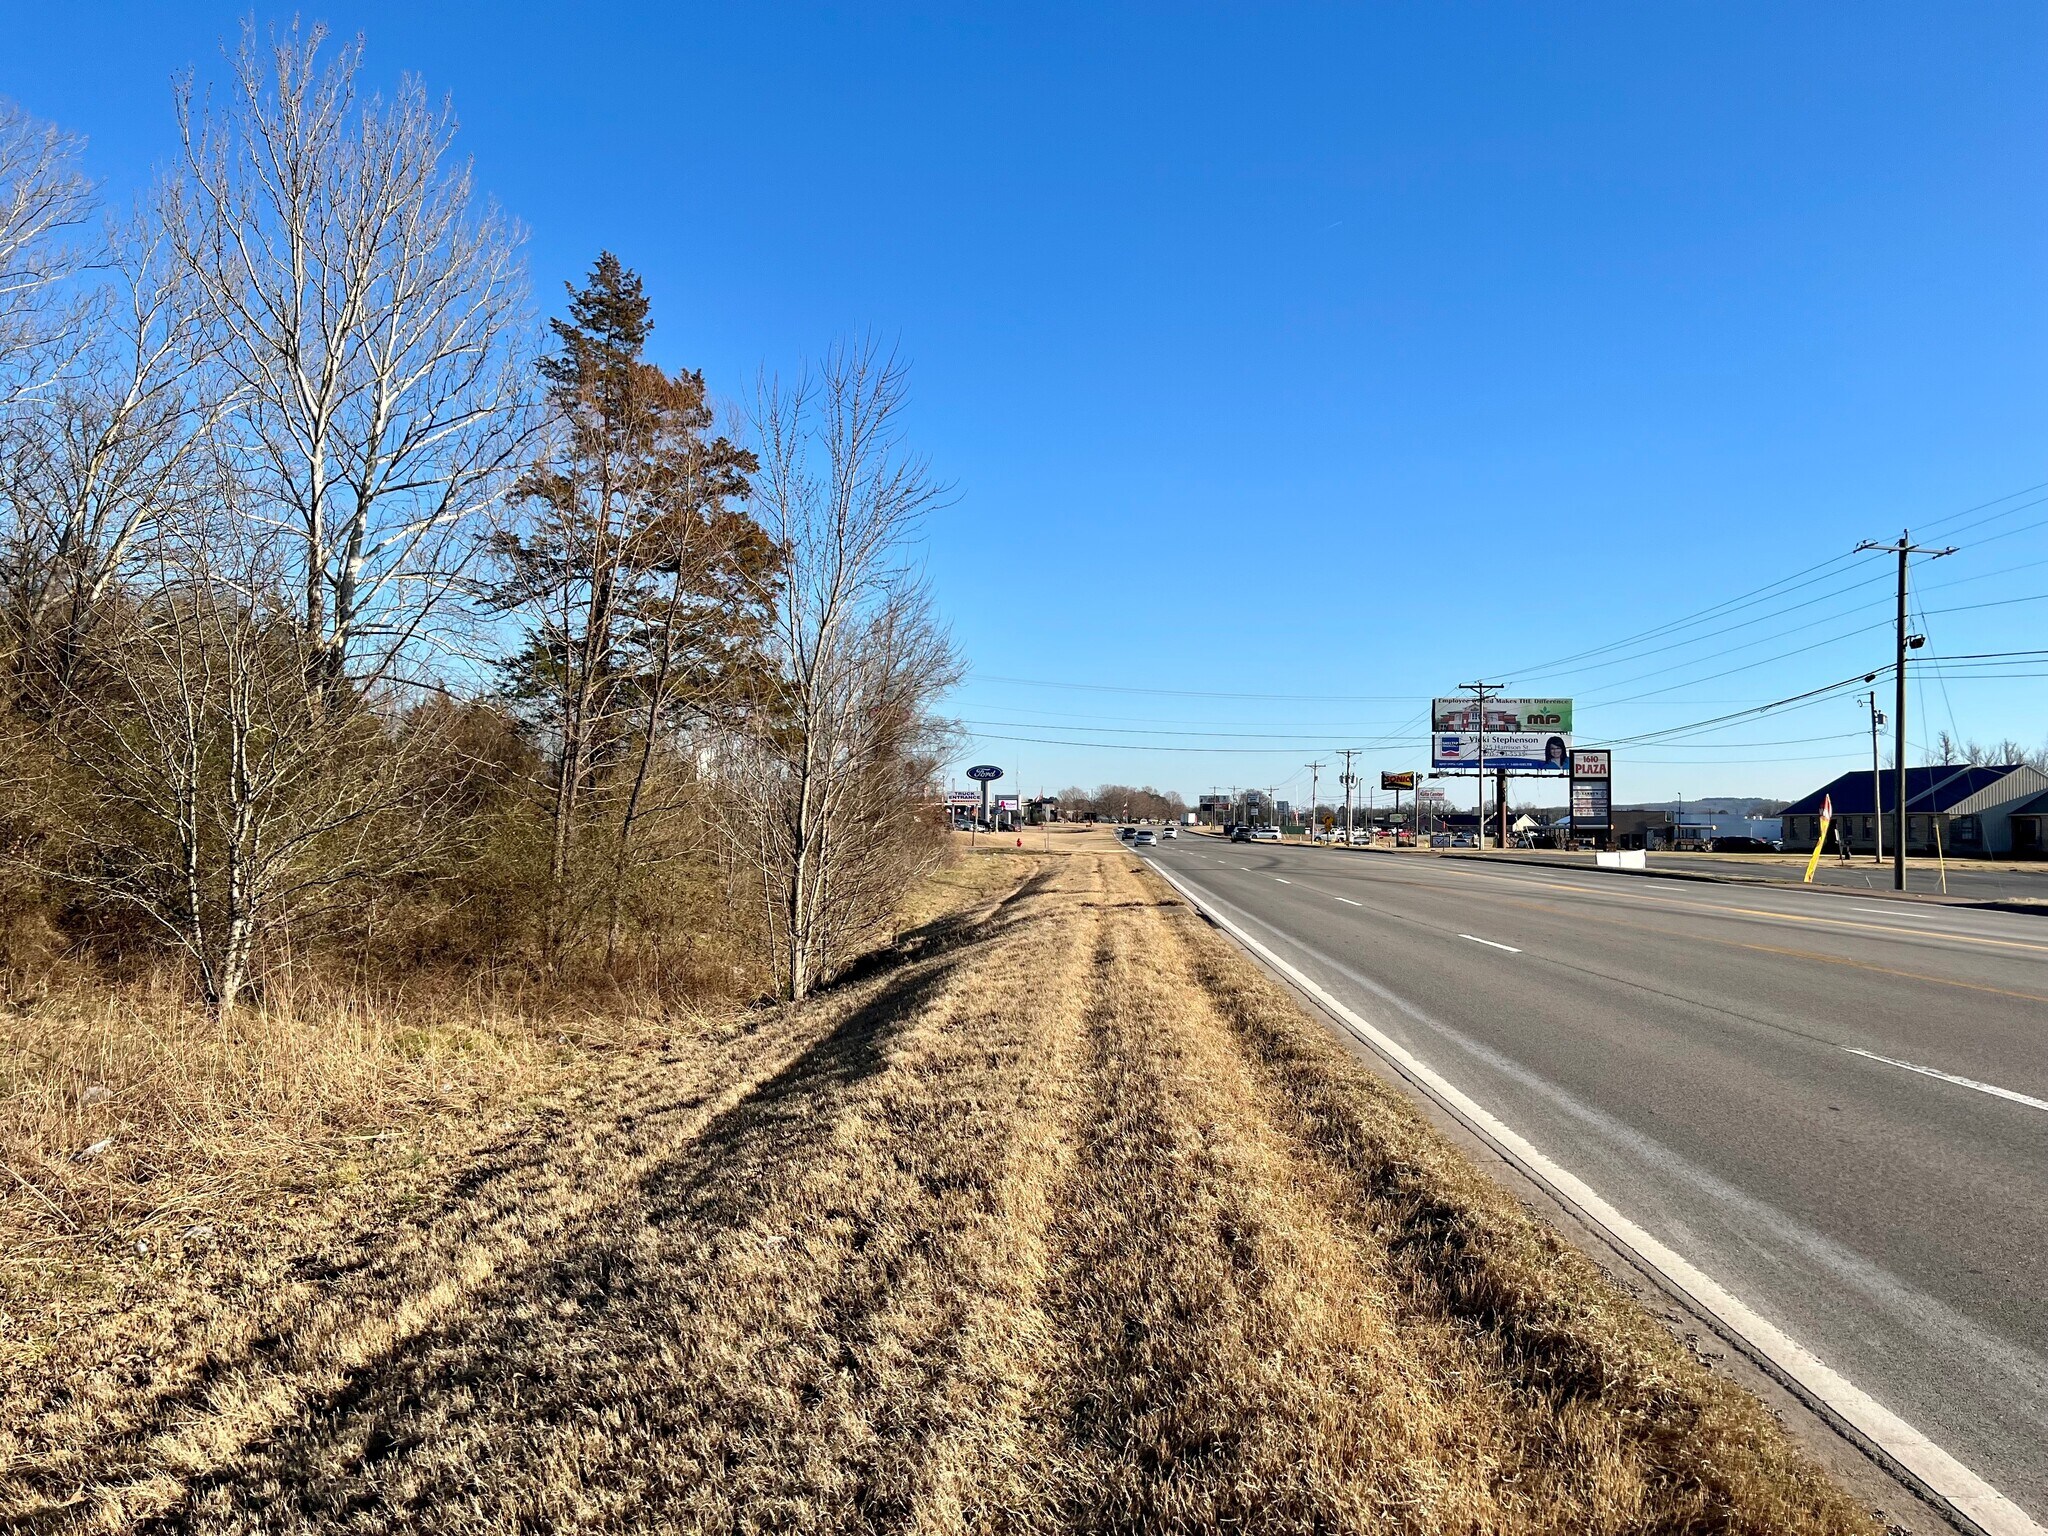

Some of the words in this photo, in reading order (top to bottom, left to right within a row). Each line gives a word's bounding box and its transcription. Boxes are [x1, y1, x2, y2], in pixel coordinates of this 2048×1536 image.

[1492, 736, 1538, 744] Stephenson
[974, 768, 996, 777] Ford
[1576, 764, 1606, 774] PLAZA
